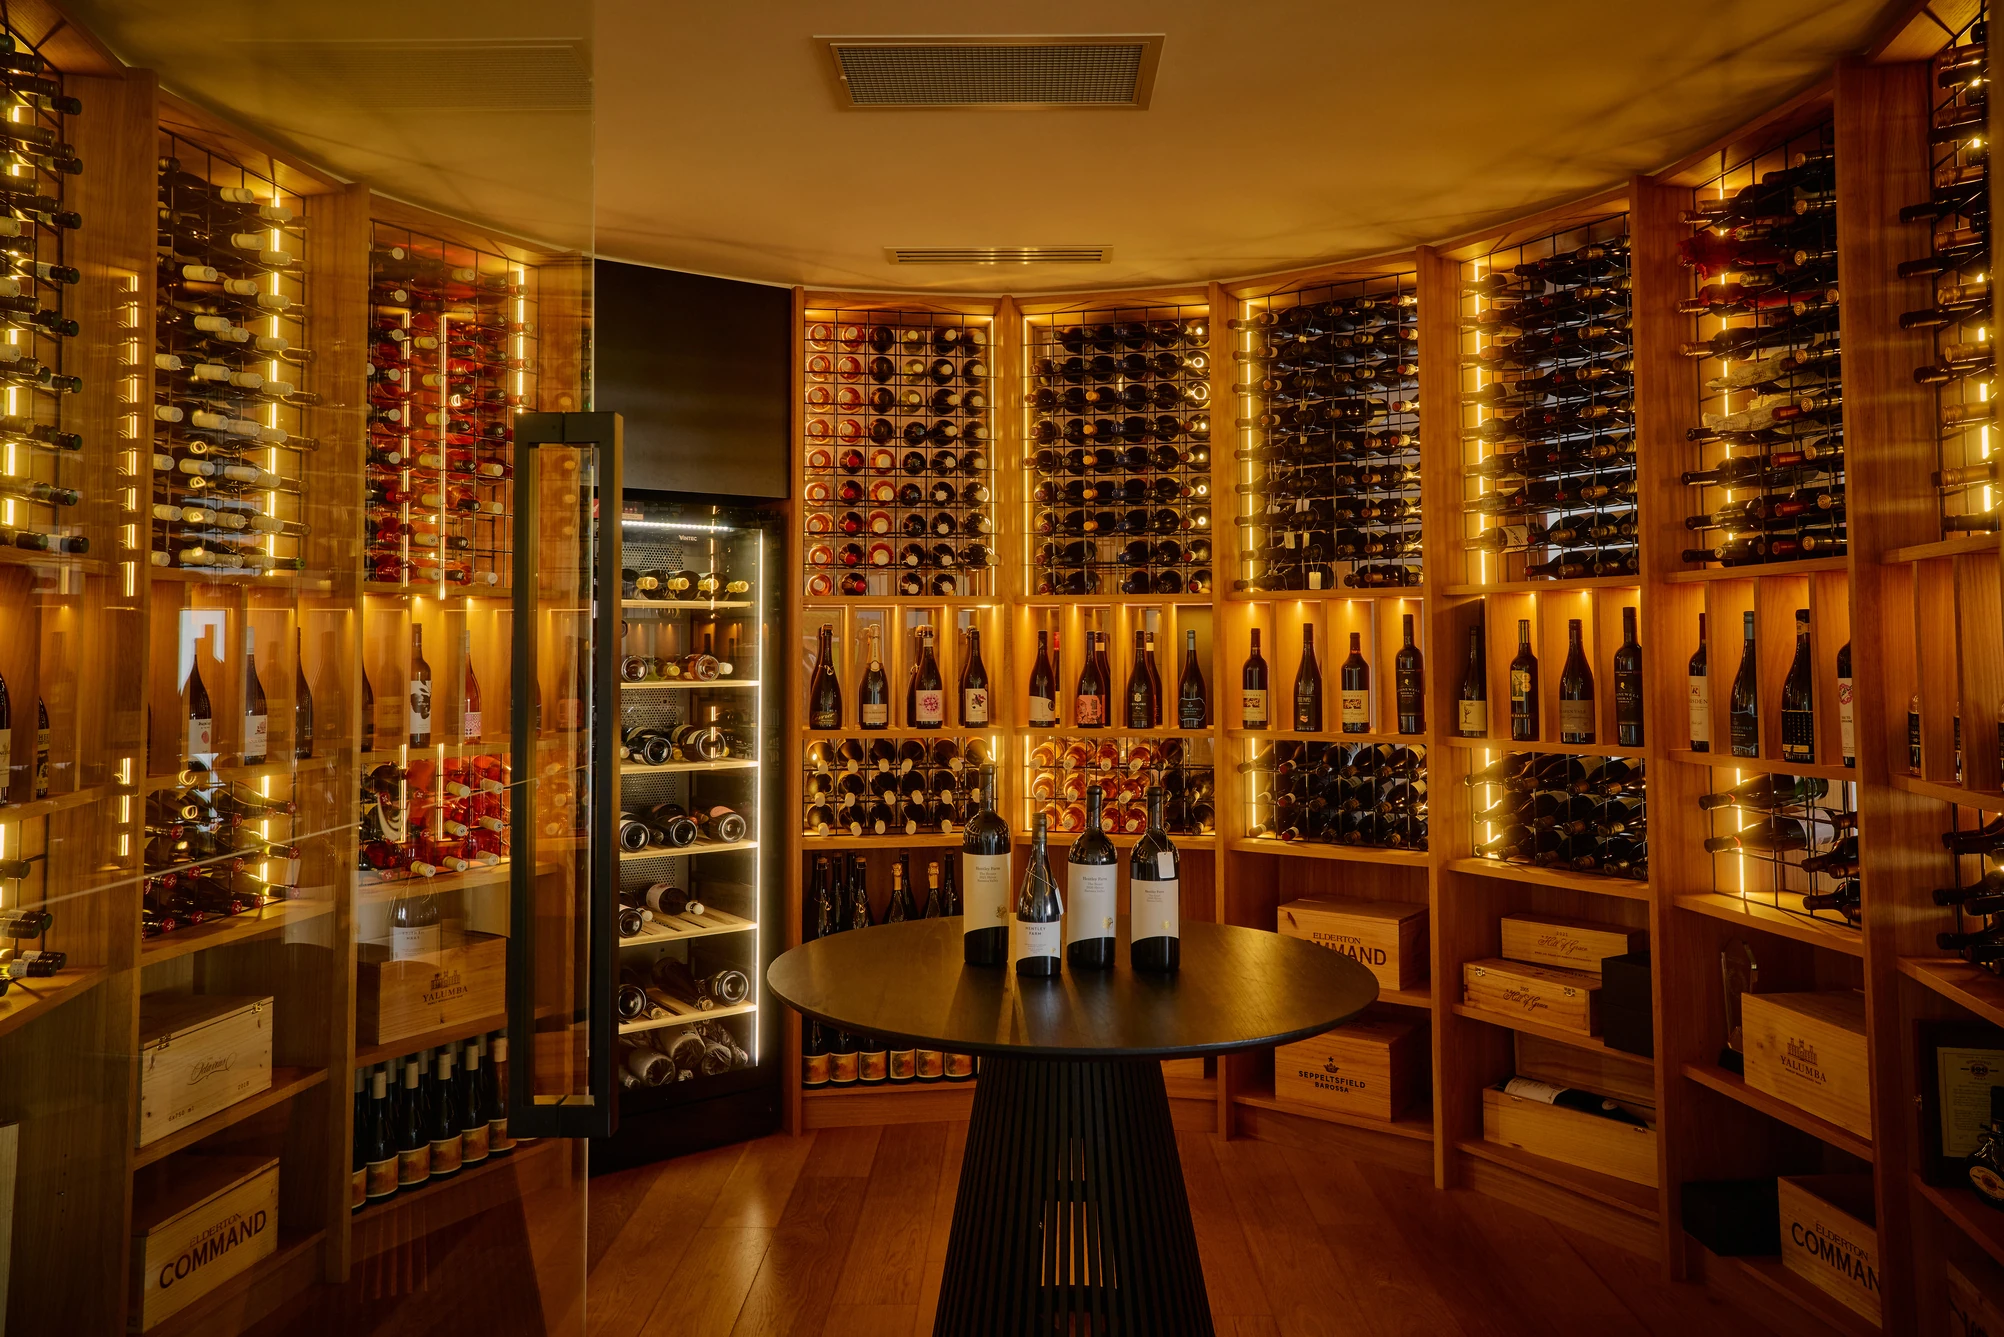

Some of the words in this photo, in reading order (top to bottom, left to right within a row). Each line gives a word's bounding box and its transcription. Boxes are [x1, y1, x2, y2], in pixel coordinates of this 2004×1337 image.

[1313, 932, 1361, 944] ELDERTON
[1538, 935, 1557, 947] Hill
[1567, 940, 1588, 955] Grace
[422, 986, 468, 1003] YALUMBA
[1503, 989, 1520, 1002] Hill
[1528, 996, 1548, 1011] Grace
[1298, 1070, 1366, 1089] SEPPELTSFIELD
[1780, 1055, 1827, 1083] YALUMBA
[1314, 1081, 1349, 1093] BAROSSA
[189, 1212, 242, 1248] ELDERTON
[159, 1209, 266, 1289] COMMAND
[1816, 1222, 1869, 1261] ELDERTON
[1791, 1222, 1881, 1295] COMMAN
